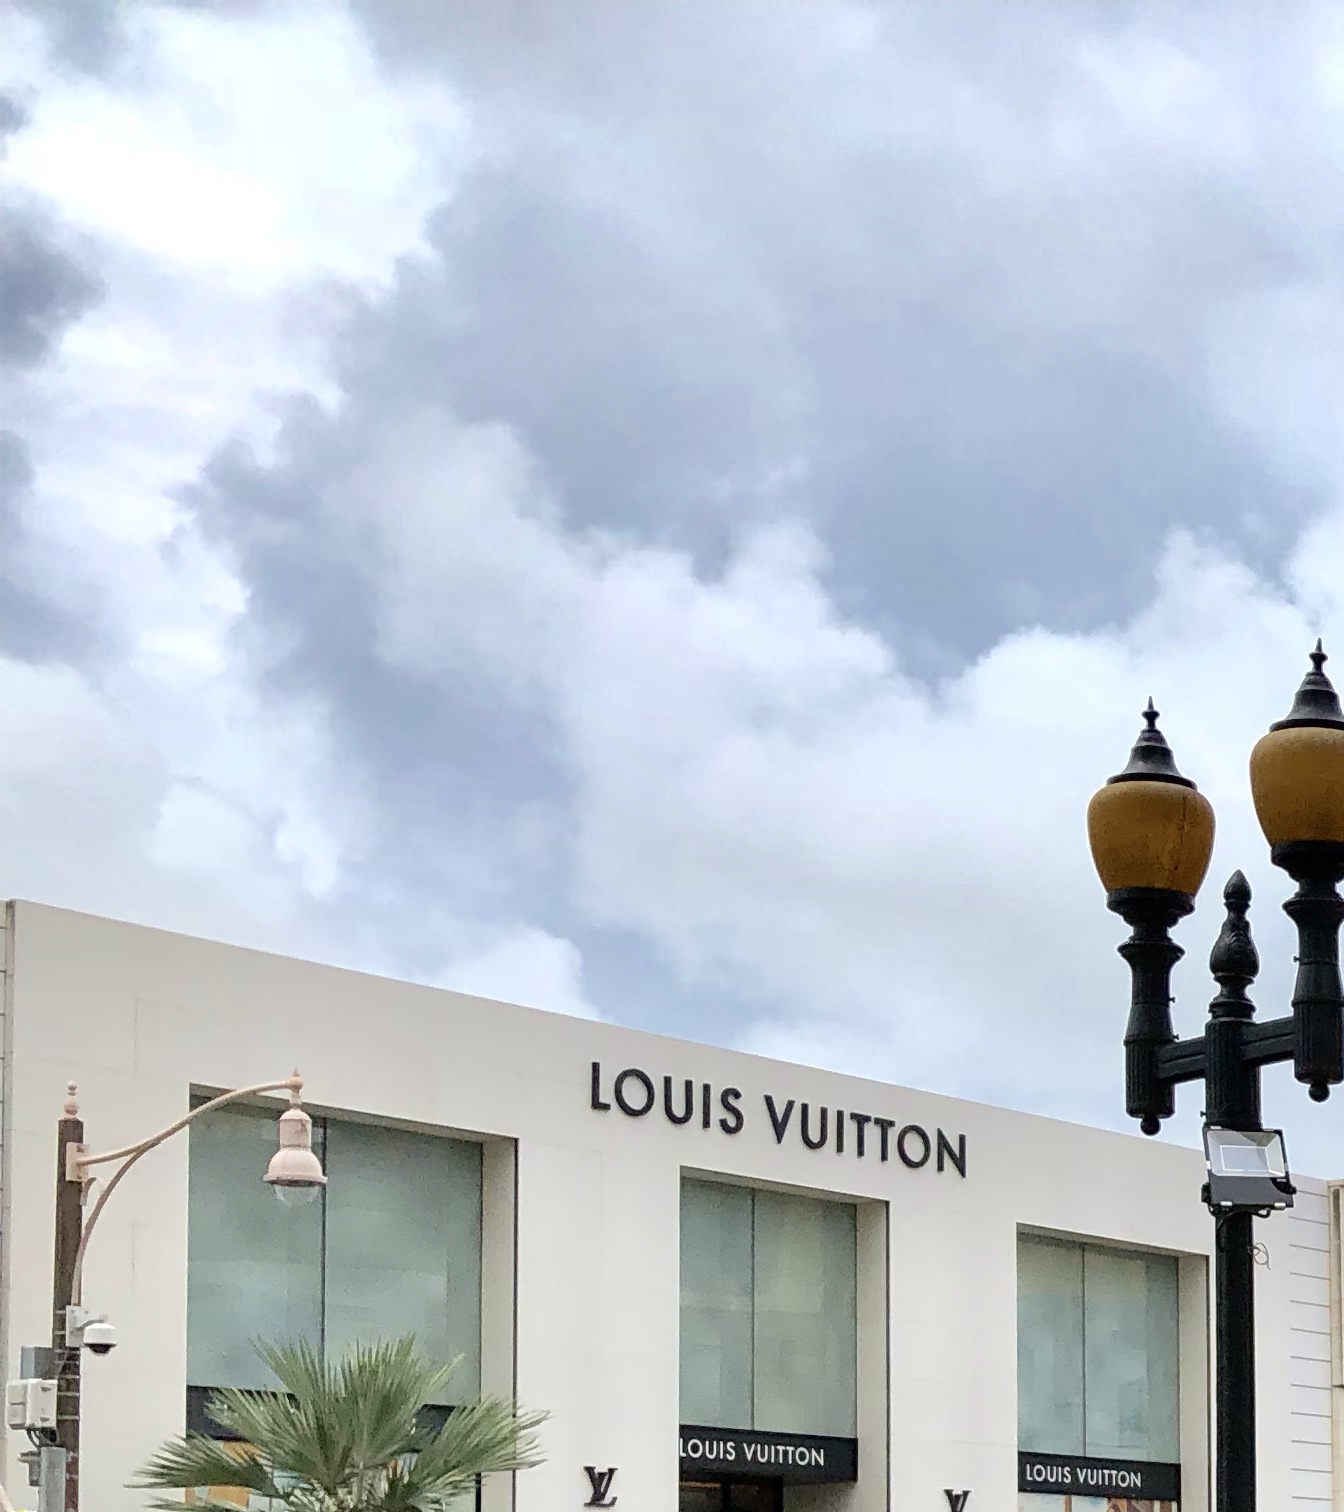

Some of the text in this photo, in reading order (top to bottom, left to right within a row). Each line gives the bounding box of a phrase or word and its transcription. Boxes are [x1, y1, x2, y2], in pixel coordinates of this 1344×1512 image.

[591, 1061, 968, 1179] LOUIS VUITTON
[679, 1437, 825, 1467] LOUIS VUITTON
[1025, 1462, 1143, 1489] LOUIS VUITTON
